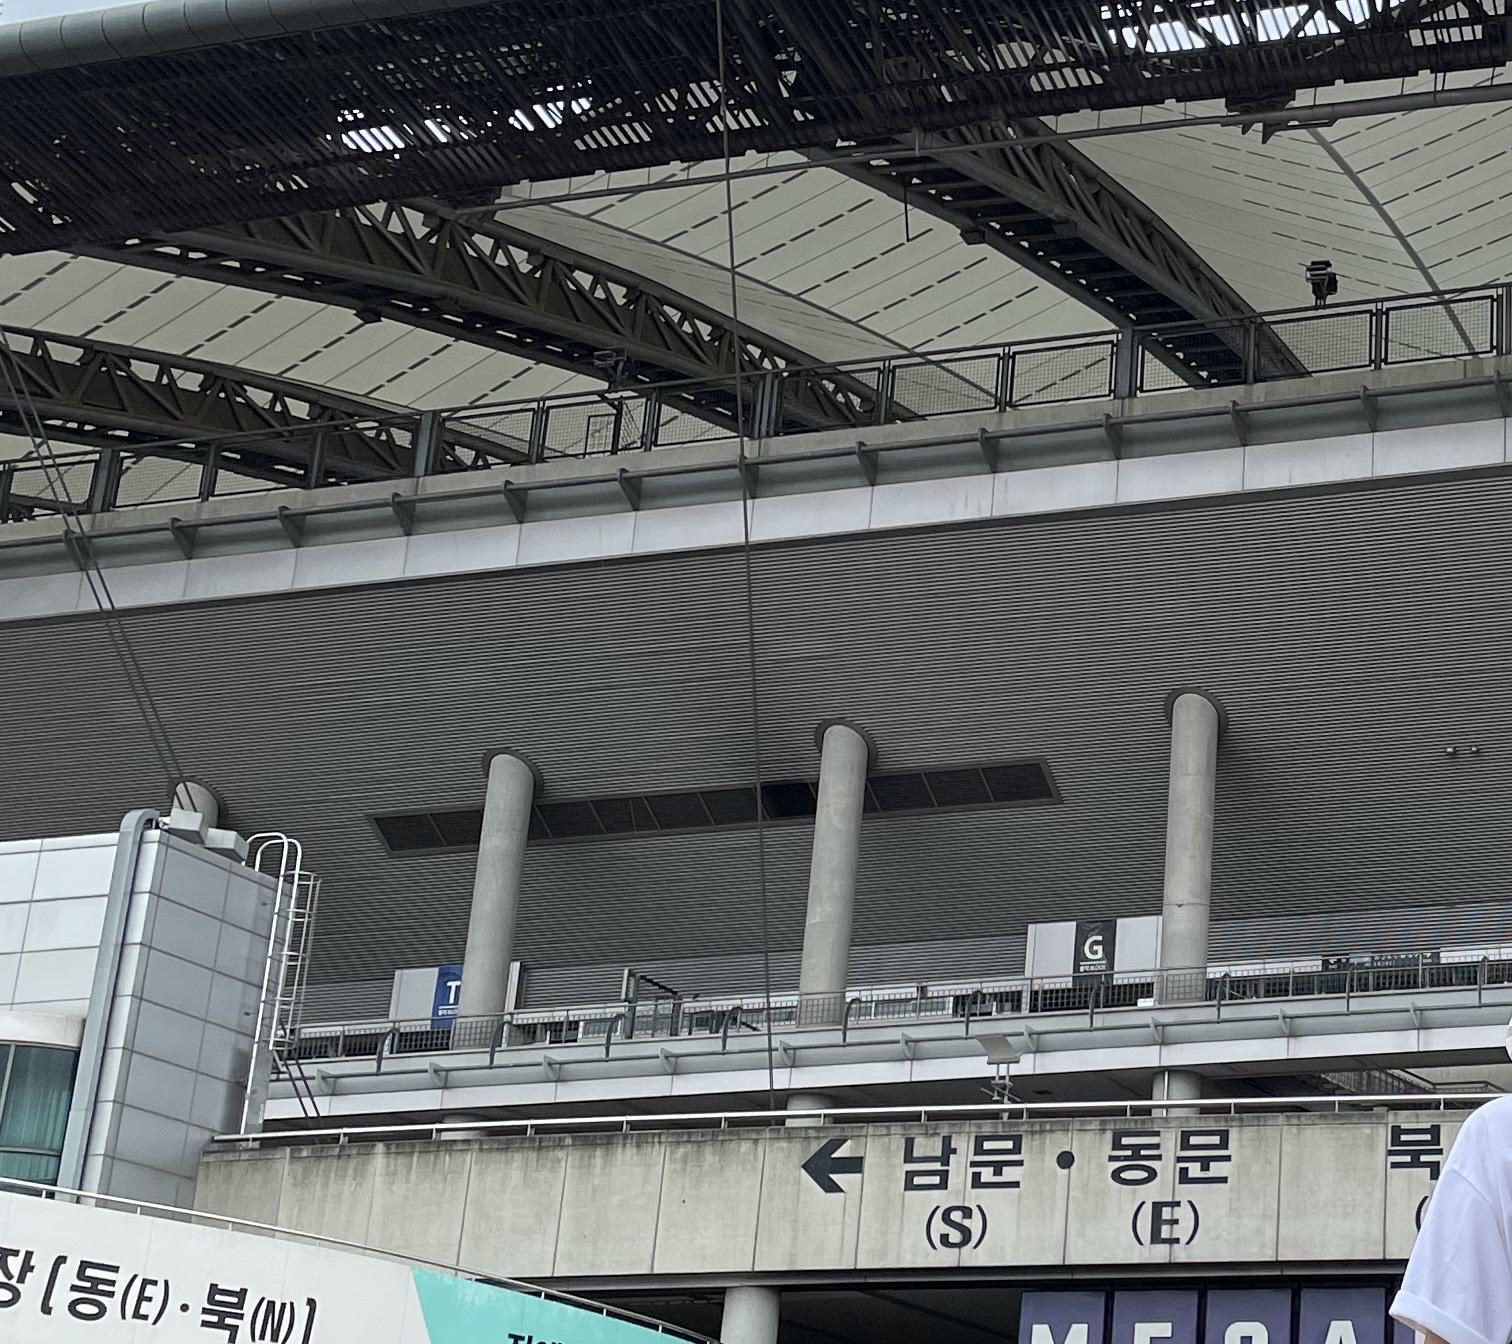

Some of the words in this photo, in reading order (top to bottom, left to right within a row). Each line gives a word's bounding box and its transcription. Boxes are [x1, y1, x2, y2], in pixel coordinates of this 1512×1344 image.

[1083, 935, 1104, 960] G
[446, 980, 462, 1004] T
[902, 1133, 1025, 1192] 남문
[1107, 1128, 1232, 1187] 동문
[1387, 1123, 1445, 1181] 북
[925, 1203, 988, 1251] (S)
[1131, 1199, 1200, 1246] (E)
